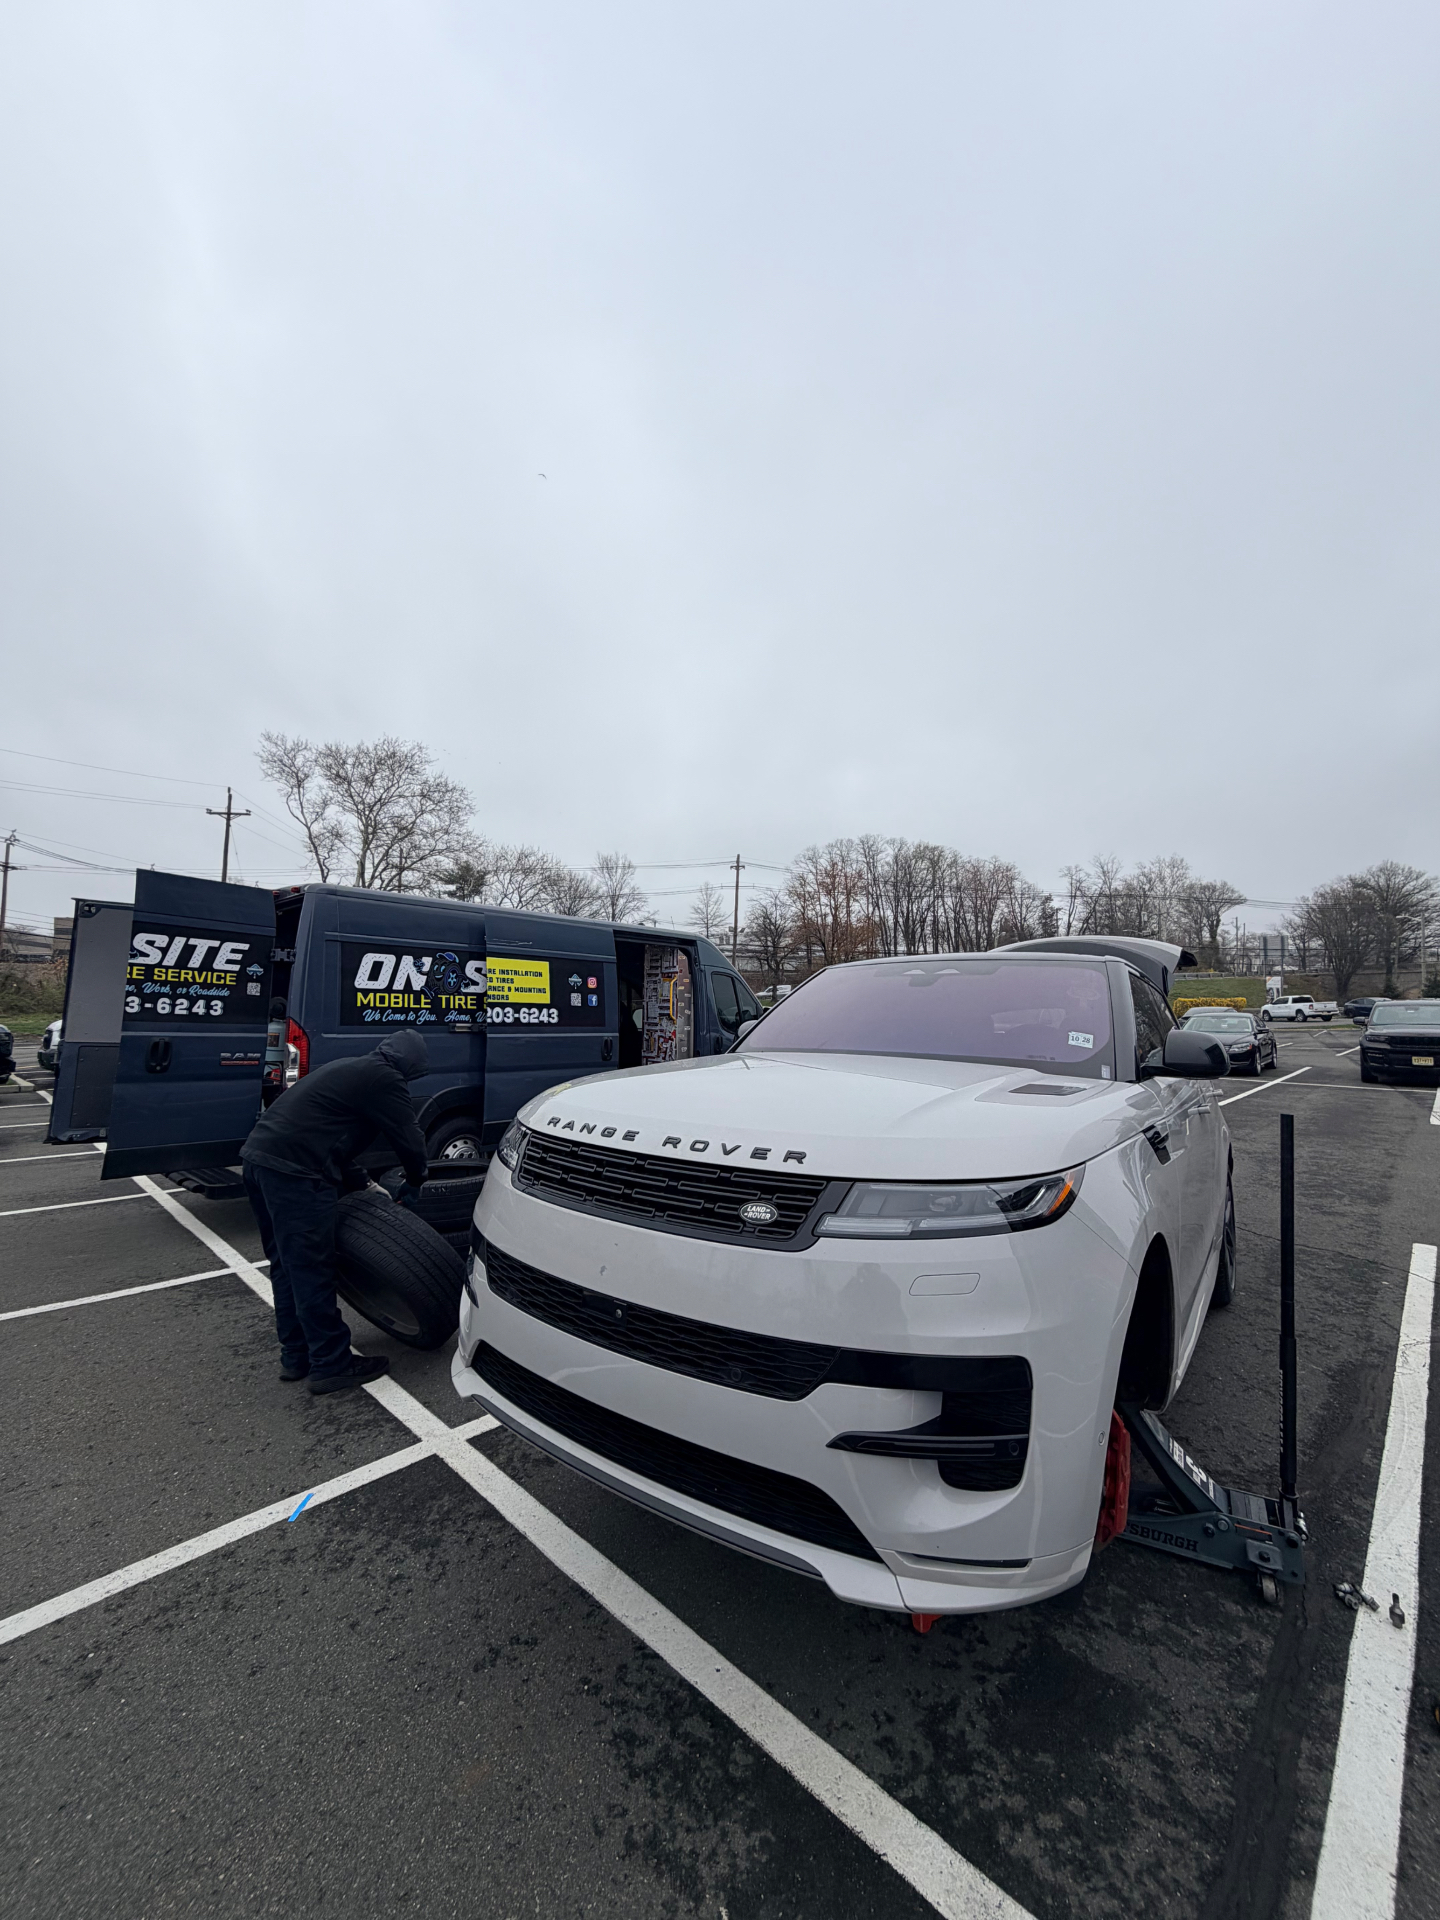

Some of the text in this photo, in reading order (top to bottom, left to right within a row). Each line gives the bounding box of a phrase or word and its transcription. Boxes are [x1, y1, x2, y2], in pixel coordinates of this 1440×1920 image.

[128, 932, 250, 971] SITE
[153, 968, 237, 985] SERVICE
[354, 952, 433, 991] ON
[499, 969, 543, 977] INSTALLATION
[142, 982, 172, 995] Work,
[189, 985, 230, 996] Roadside
[514, 986, 547, 994] MOUNTING
[125, 996, 224, 1016] 3-6243
[356, 992, 431, 1008] MOBILE
[438, 994, 477, 1009] TIRE
[363, 1009, 381, 1021] We
[382, 1009, 406, 1021] Come
[407, 1011, 415, 1020] to
[415, 1010, 438, 1024] You.
[444, 1010, 472, 1022] Home,
[547, 1116, 807, 1165] RANGE ROVER
[747, 1205, 766, 1213] LAND
[747, 1211, 771, 1220] ROVER
